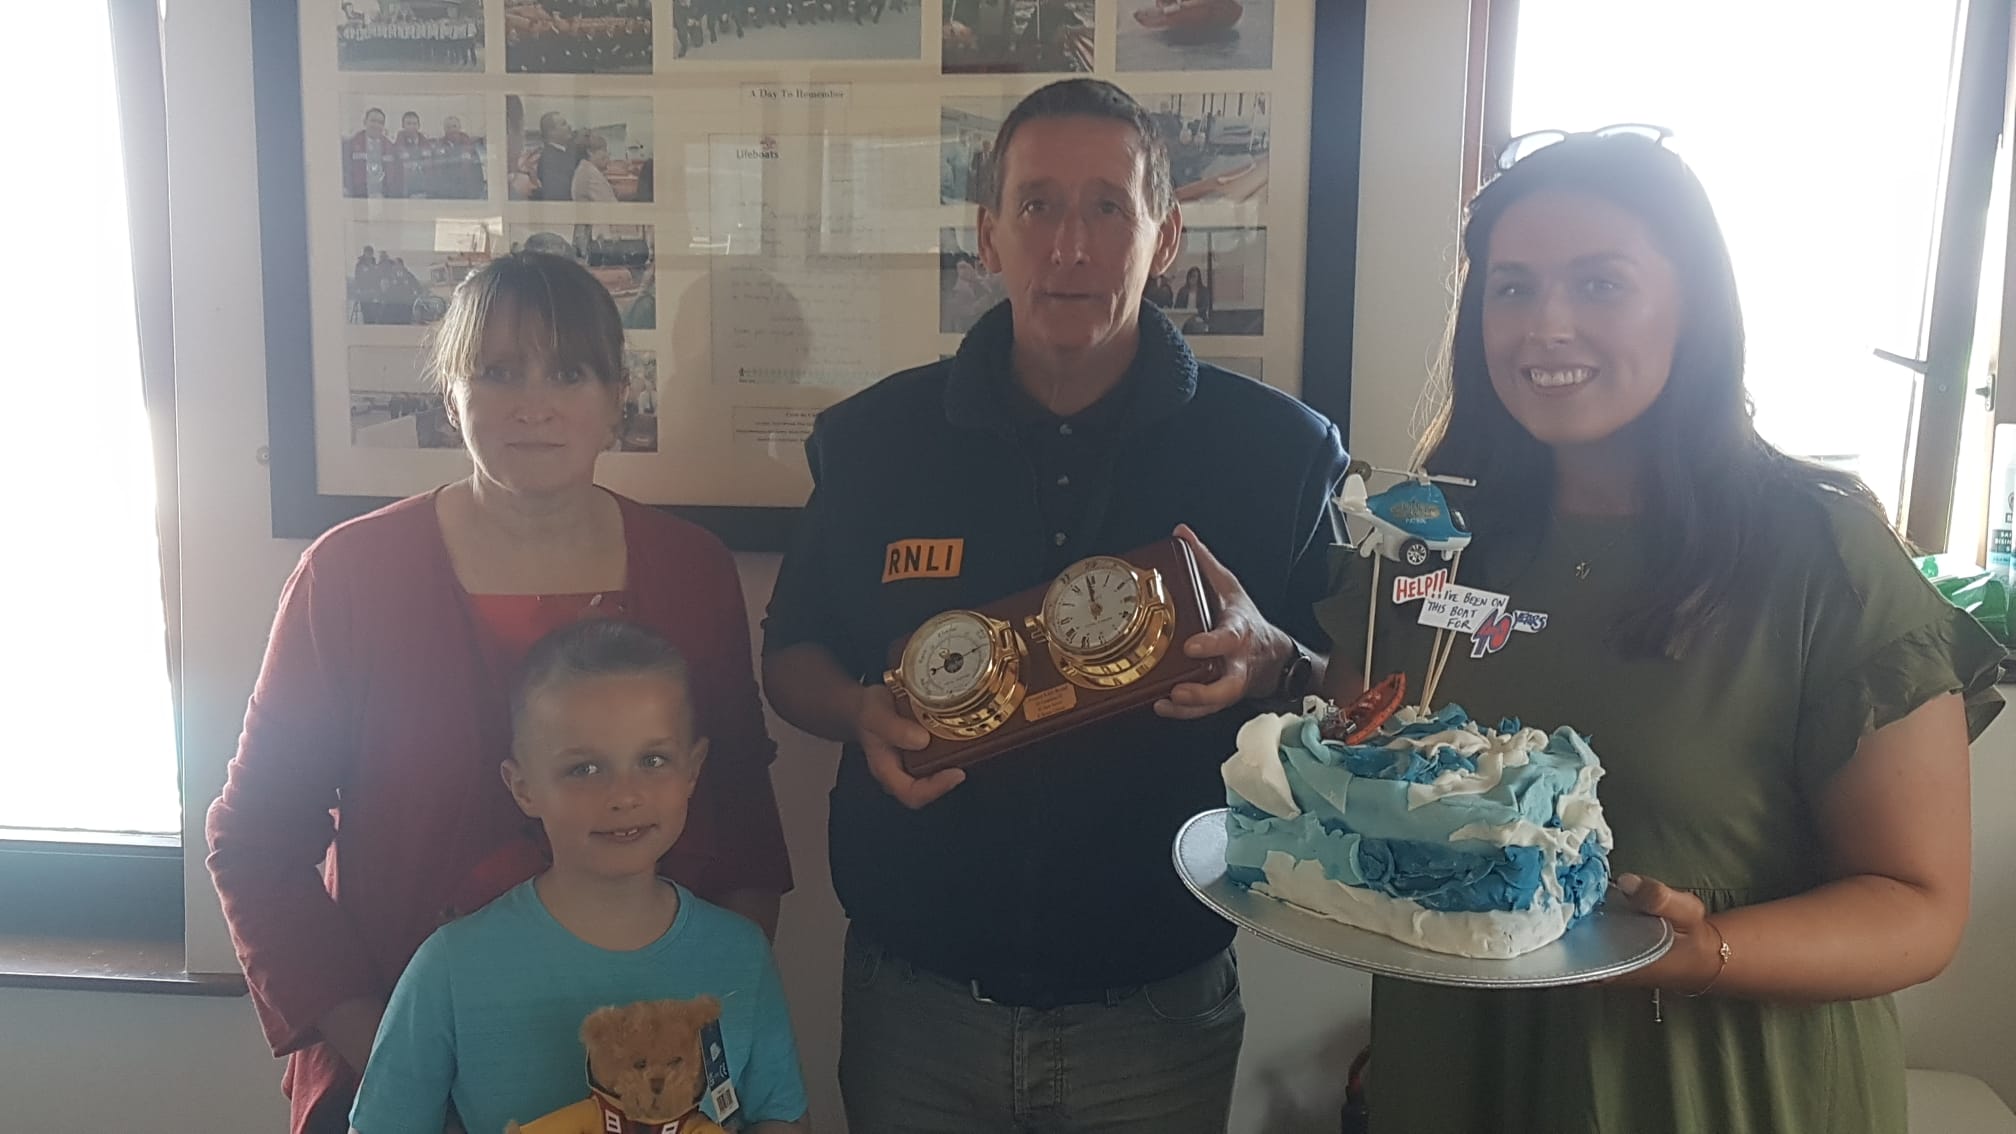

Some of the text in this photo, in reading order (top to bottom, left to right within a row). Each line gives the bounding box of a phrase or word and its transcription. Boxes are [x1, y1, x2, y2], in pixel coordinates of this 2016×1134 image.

[759, 89, 777, 100] Day
[782, 89, 793, 98] To
[796, 89, 845, 98] Remember
[736, 149, 779, 160] Lifeboats
[888, 545, 954, 575] RNLI
[1396, 570, 1446, 601] HELP!!
[1463, 592, 1488, 606] BEEN
[1491, 597, 1505, 608] ON
[1427, 601, 1478, 618] THIS BOAT
[1447, 617, 1473, 630] FOR
